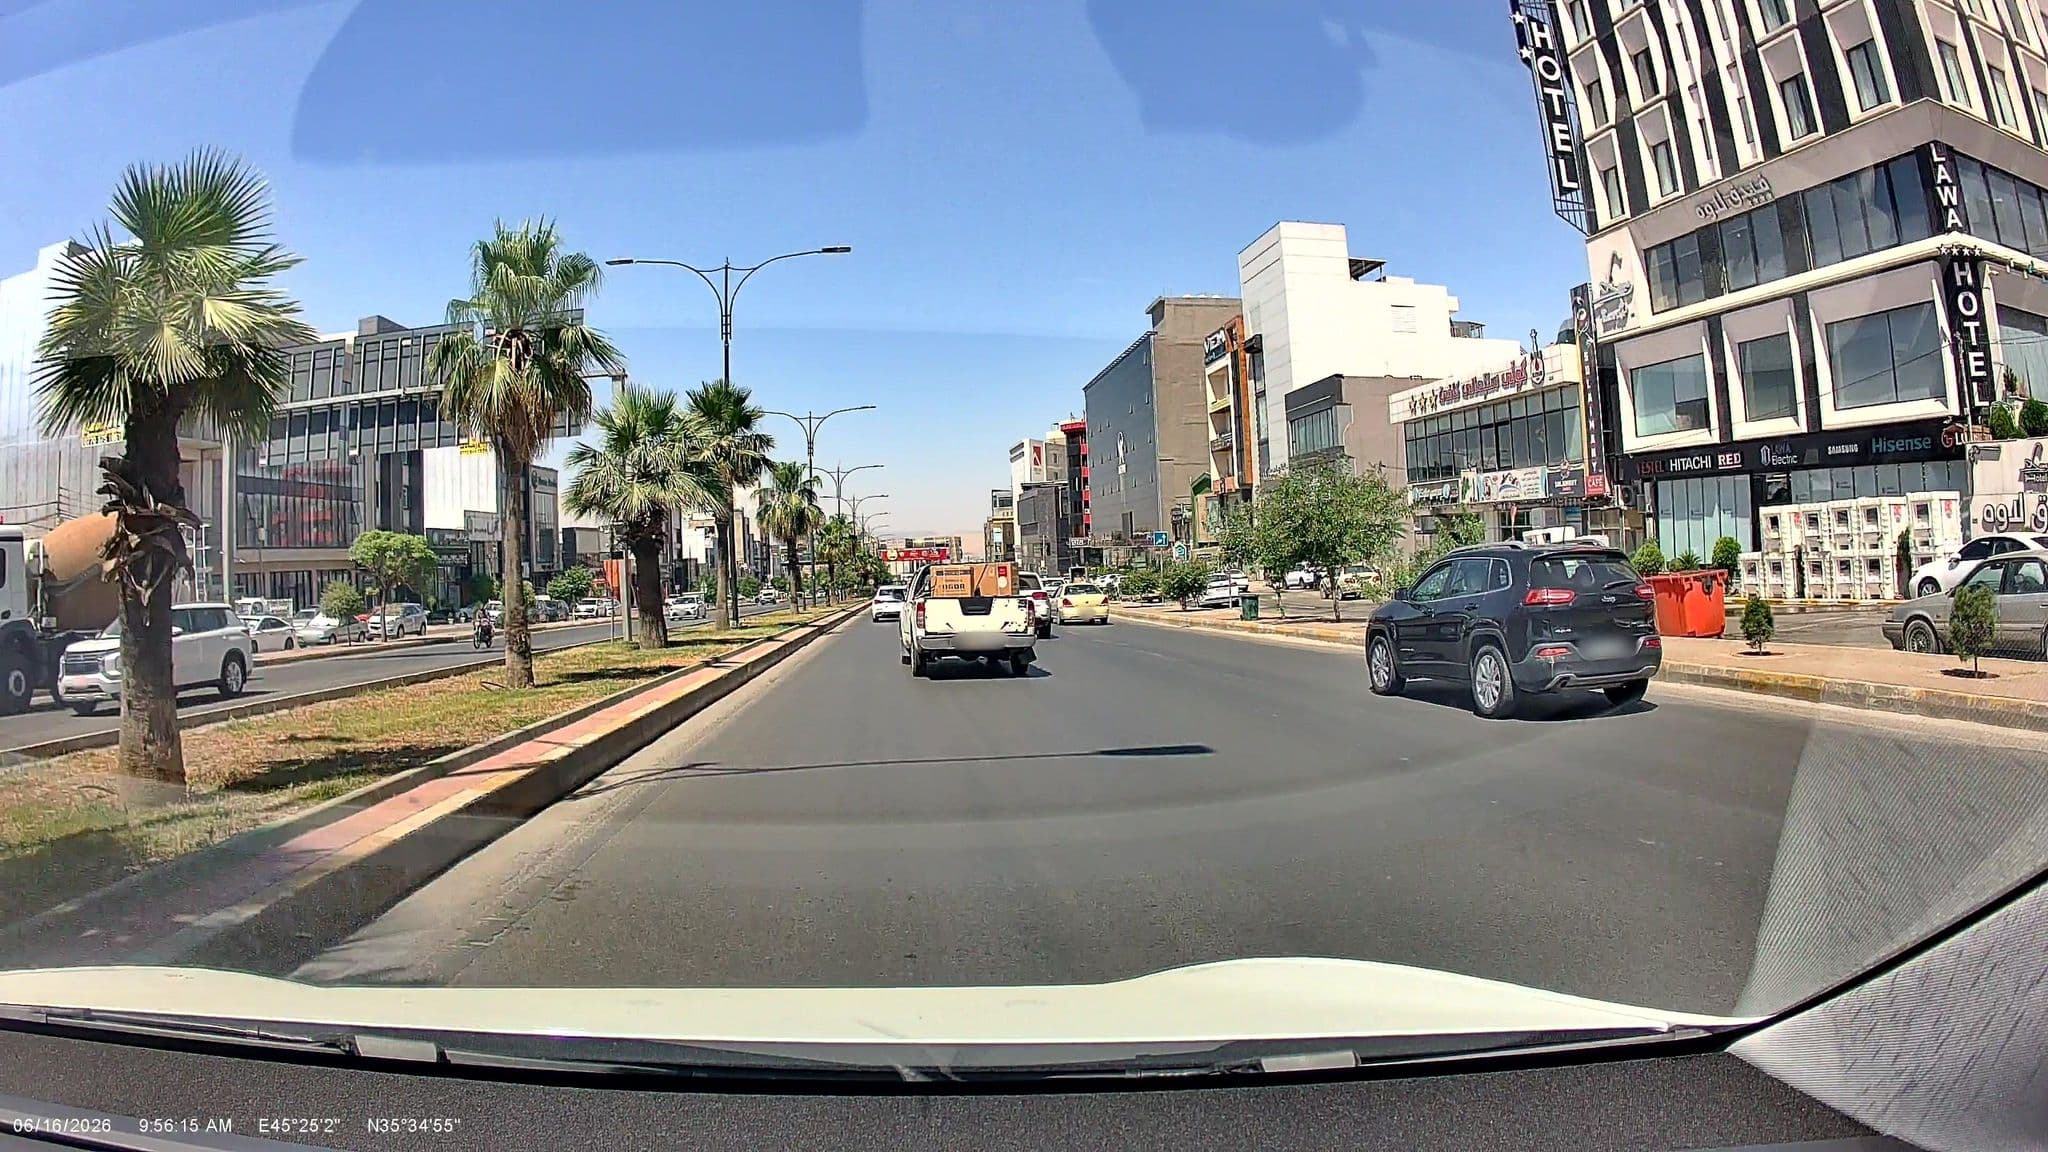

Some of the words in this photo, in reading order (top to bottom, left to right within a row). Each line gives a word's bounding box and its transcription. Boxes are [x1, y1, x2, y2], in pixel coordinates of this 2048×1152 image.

[1530, 21, 1579, 189] HOTEL
[1930, 143, 1963, 228] LAWA
[1953, 261, 1990, 407] HOTEL
[1827, 444, 1859, 455] SAMSUNG
[1871, 436, 1932, 454] Hisense
[1670, 456, 1712, 472] HITACHI
[1717, 453, 1742, 466] RED
